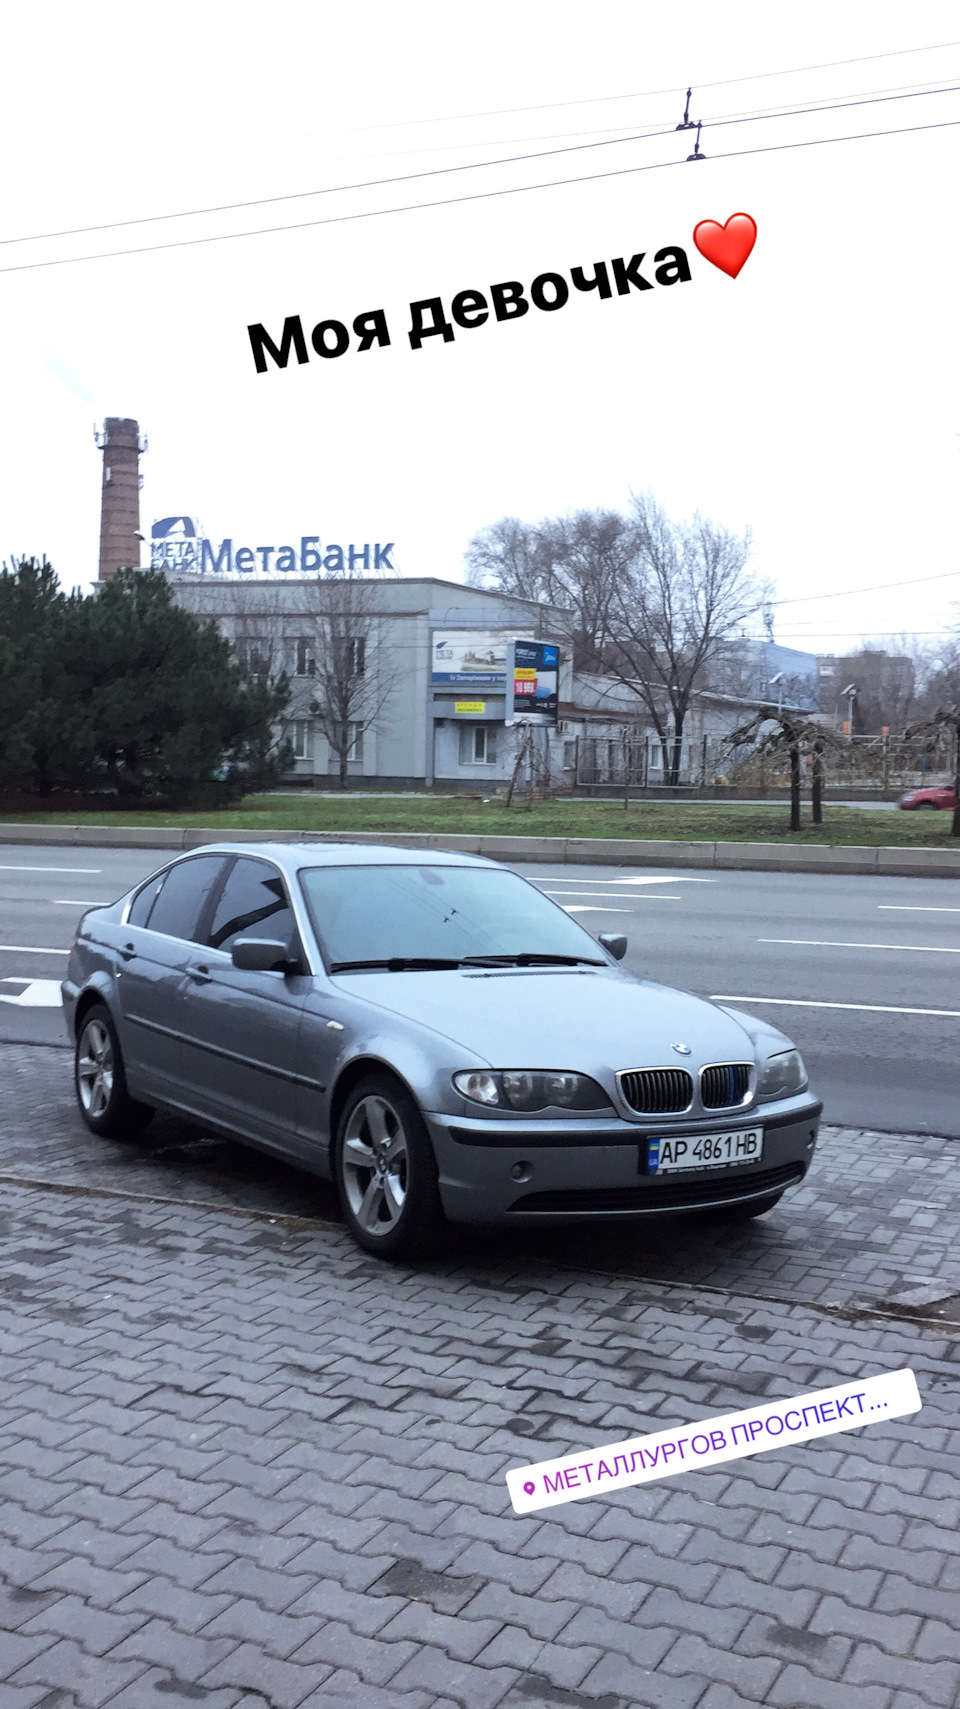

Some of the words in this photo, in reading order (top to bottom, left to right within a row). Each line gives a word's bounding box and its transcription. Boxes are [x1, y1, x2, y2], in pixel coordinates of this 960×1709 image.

[151, 541, 195, 558] МЕТА
[202, 536, 395, 573] МетаБанк
[660, 1141, 688, 1164] AP
[692, 1136, 732, 1161] 4861
[735, 1132, 757, 1157] HB
